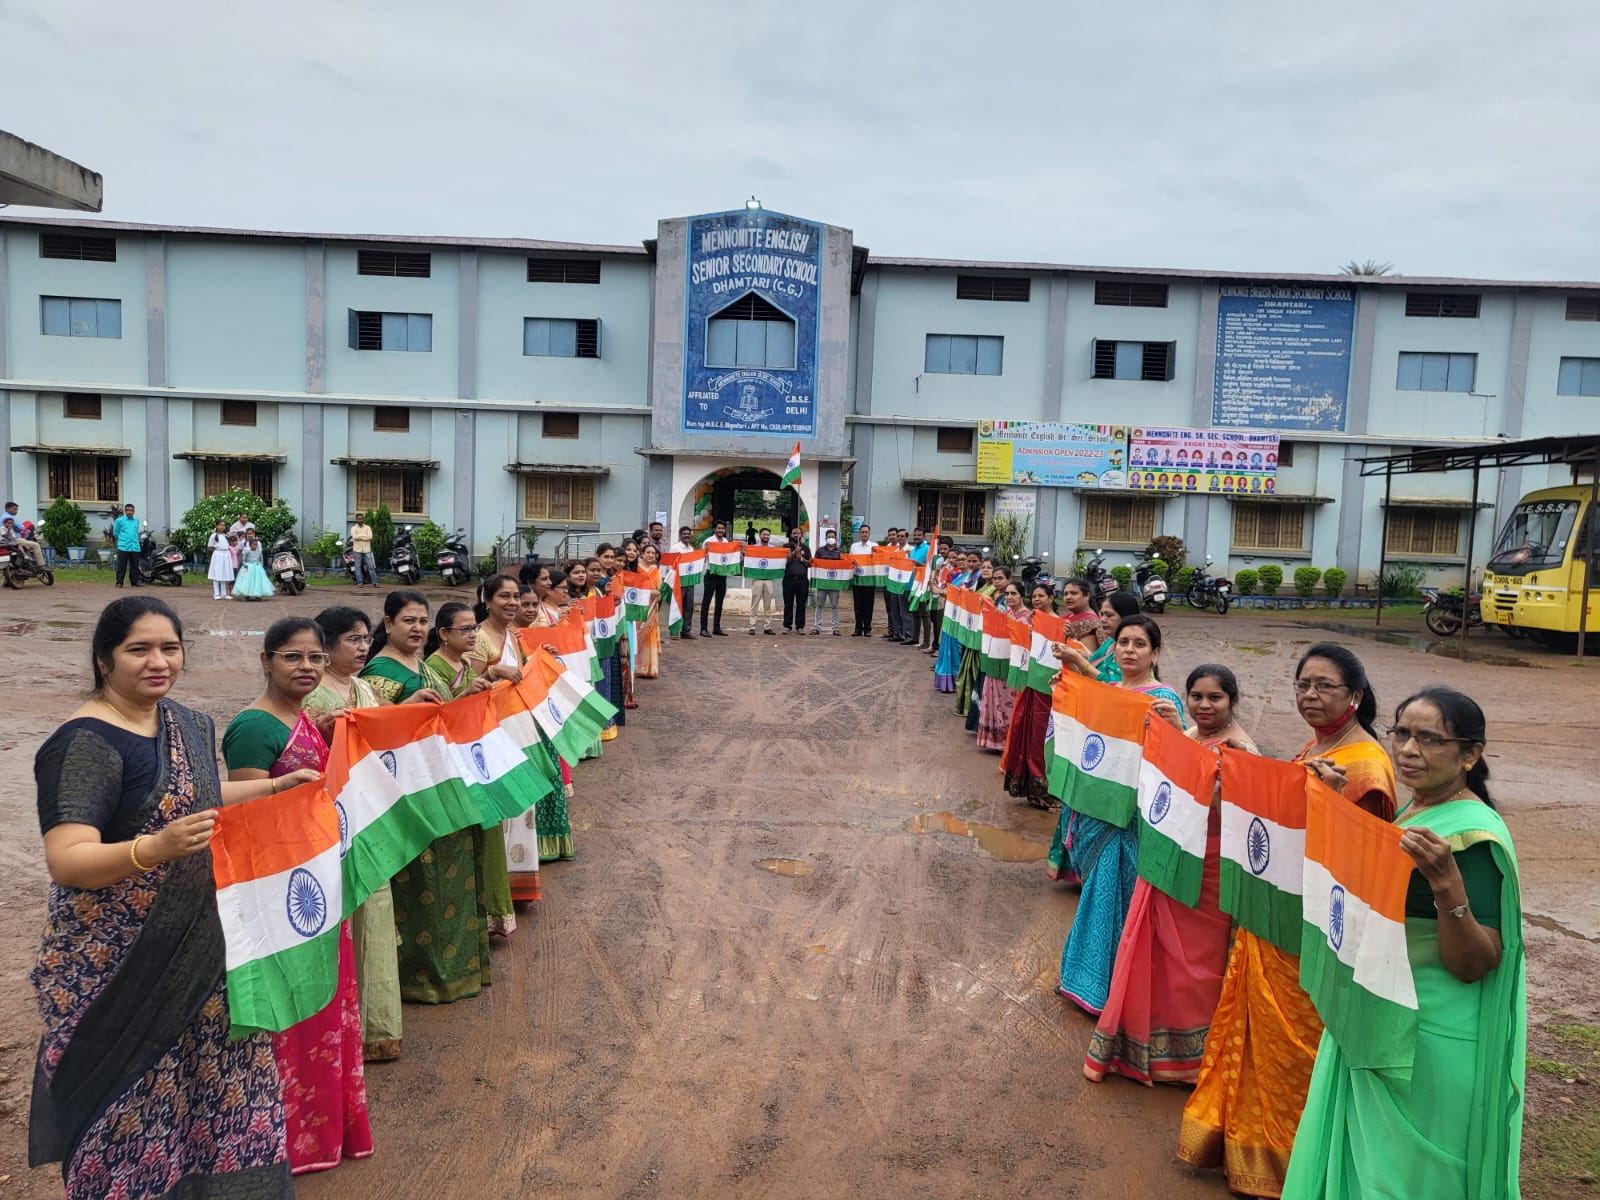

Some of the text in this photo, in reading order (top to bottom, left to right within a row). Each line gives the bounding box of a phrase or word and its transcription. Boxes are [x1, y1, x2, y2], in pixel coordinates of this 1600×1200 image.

[702, 228, 810, 253] MENNONITE ENGLISH
[692, 254, 817, 286] SENIOR SECONDARY SCHOOL
[713, 277, 803, 298] DHAMTARI (C.G.)
[688, 392, 719, 400] AFFILIATED
[786, 407, 807, 415] DELHI
[1031, 431, 1054, 441] English
[1088, 434, 1109, 443] School
[1146, 430, 1178, 439] MENNONITE
[1180, 431, 1193, 439] ENG.
[1018, 447, 1053, 456] ADMISSION
[1494, 576, 1509, 584] SCHOOL
[1513, 577, 1522, 585] BUS
